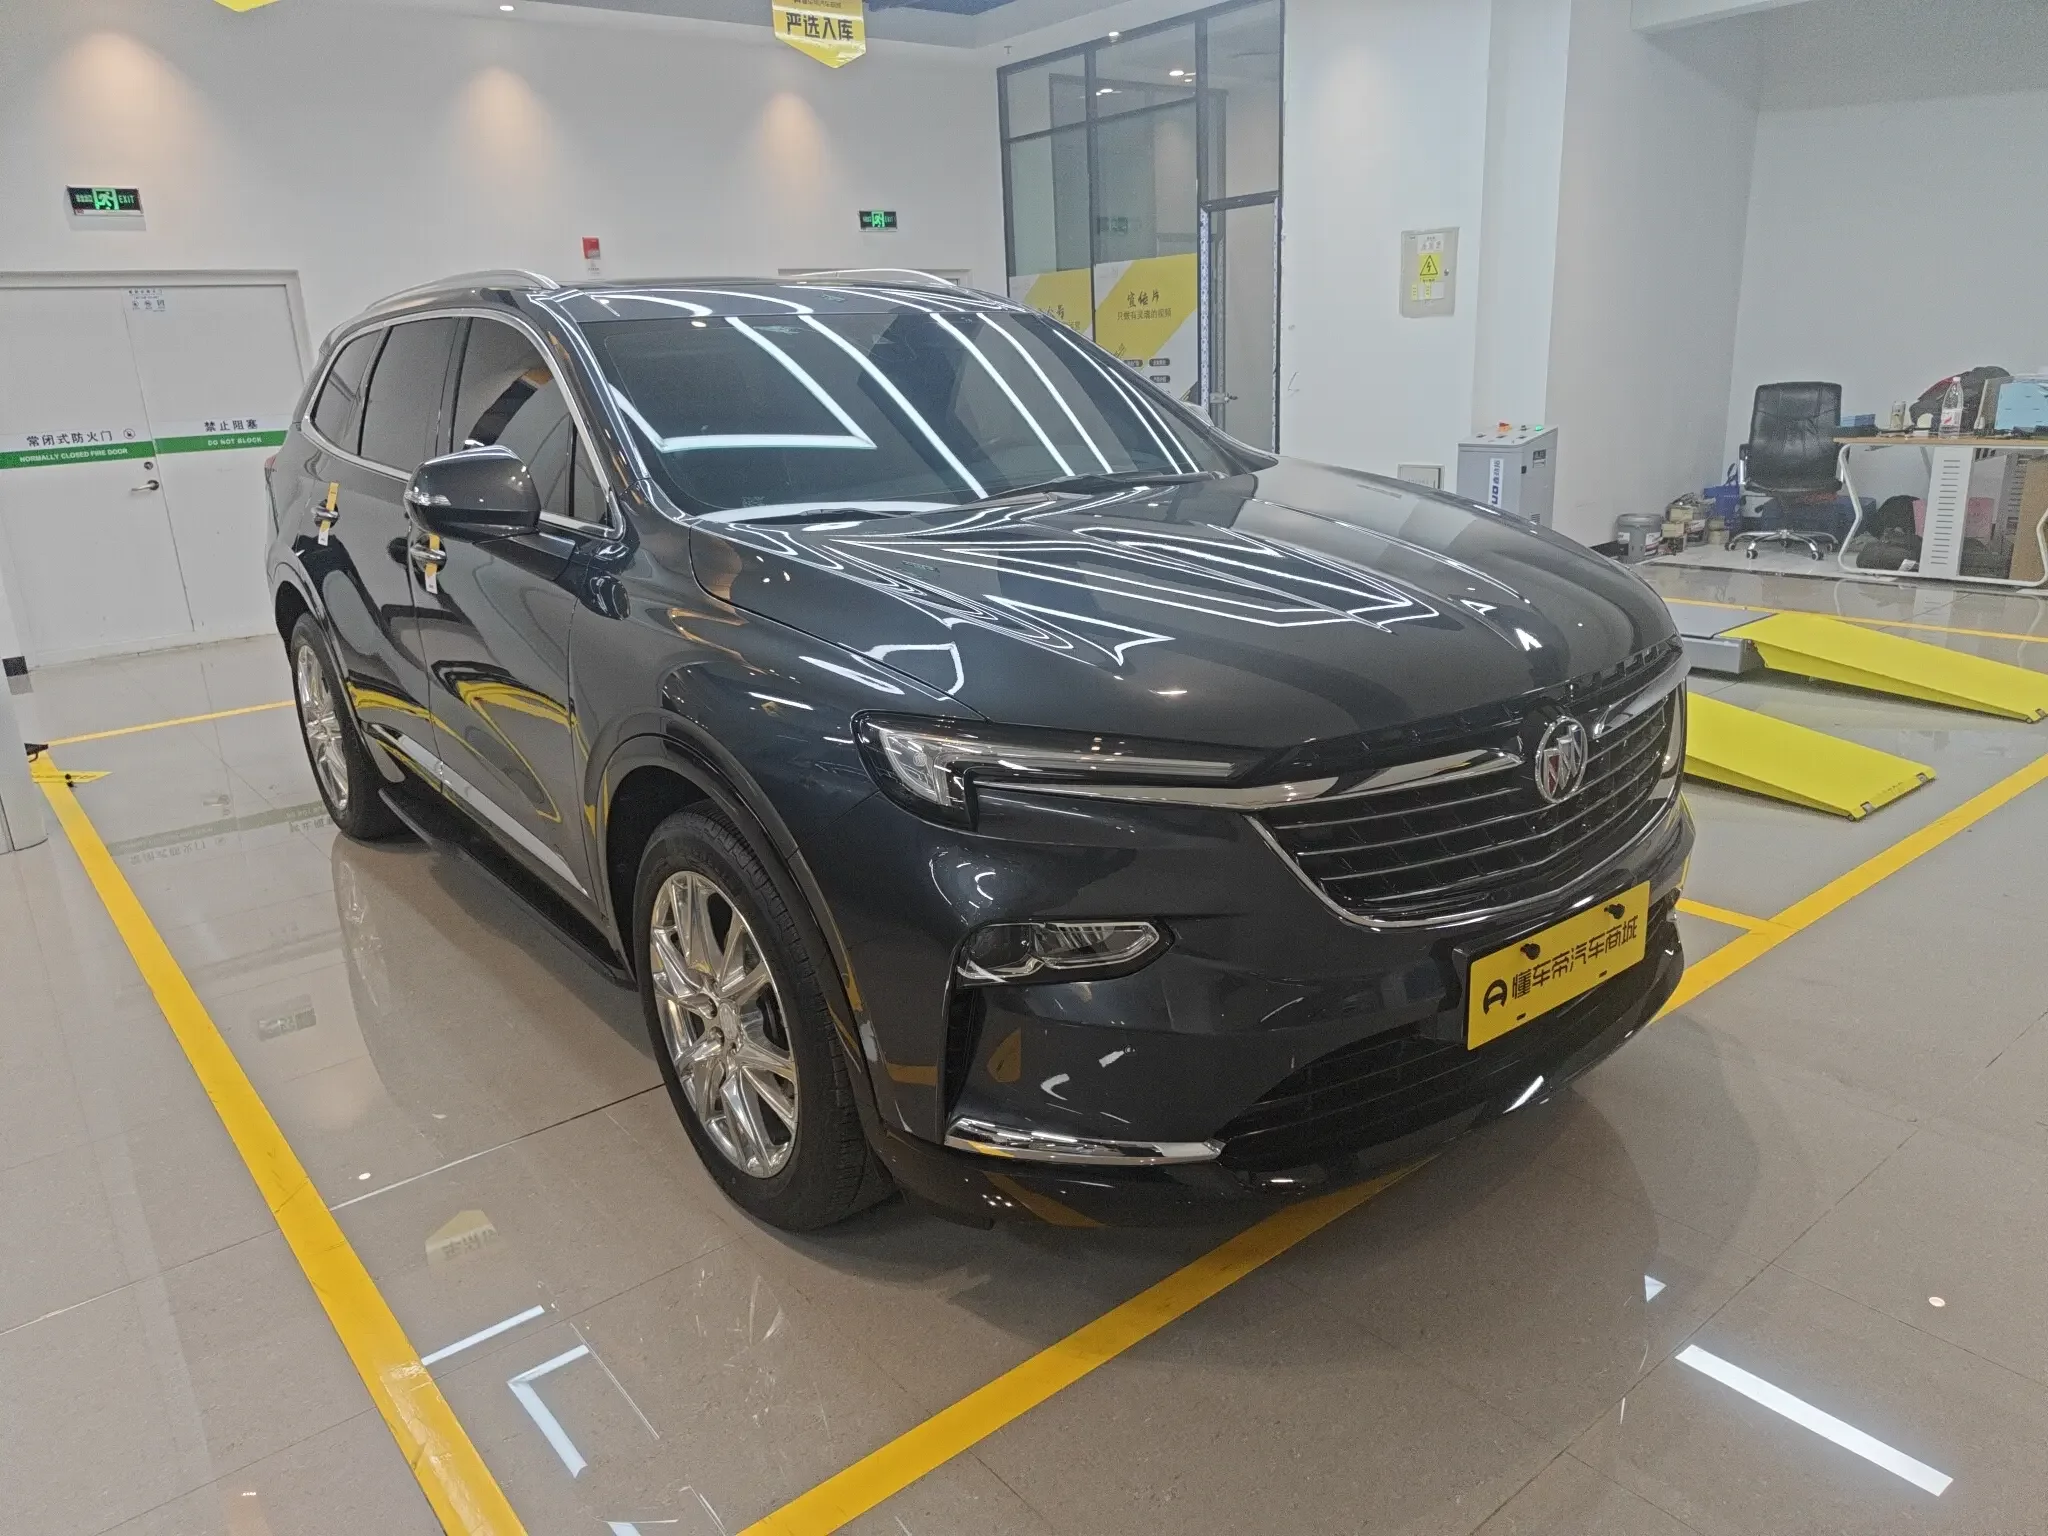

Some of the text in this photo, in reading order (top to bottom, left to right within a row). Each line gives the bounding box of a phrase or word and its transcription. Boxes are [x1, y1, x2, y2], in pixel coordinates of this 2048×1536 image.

[785, 12, 854, 41] 严选入库
[118, 194, 135, 204] EXIT
[1127, 289, 1160, 309] 宣传片
[204, 419, 258, 432] 禁止阻塞
[26, 430, 113, 447] 常闭式防火门
[207, 438, 218, 446] DO
[237, 436, 262, 444] BLOCK
[20, 447, 128, 463] NORMALLY CLOSED FIRE DOOR
[1511, 914, 1639, 999] 懂车帝汽车商城
